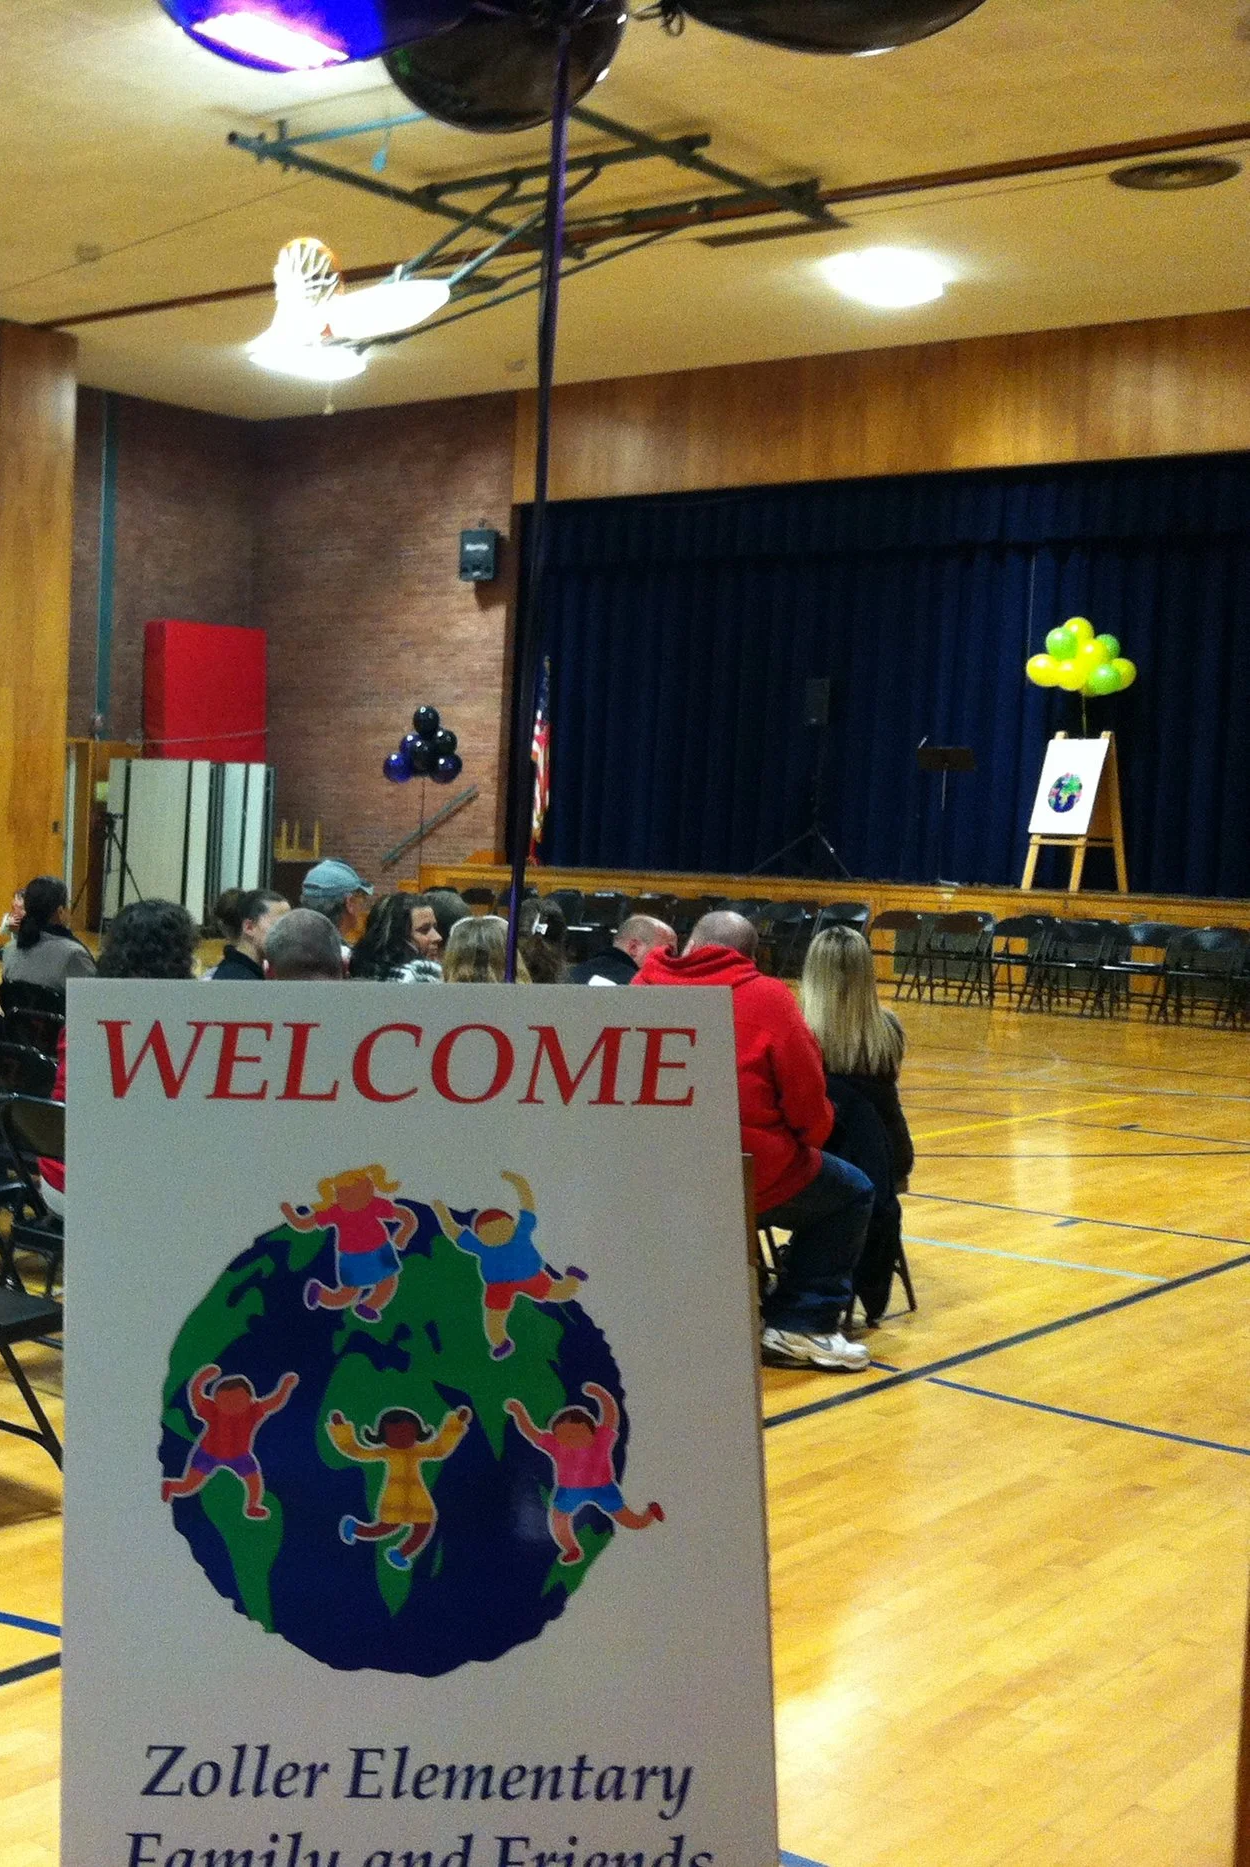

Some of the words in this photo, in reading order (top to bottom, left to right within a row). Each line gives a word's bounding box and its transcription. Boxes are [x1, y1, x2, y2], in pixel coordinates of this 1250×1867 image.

[97, 1018, 697, 1107] WELCOME
[140, 1743, 330, 1799] Zoller
[344, 1745, 694, 1821] Elementary
